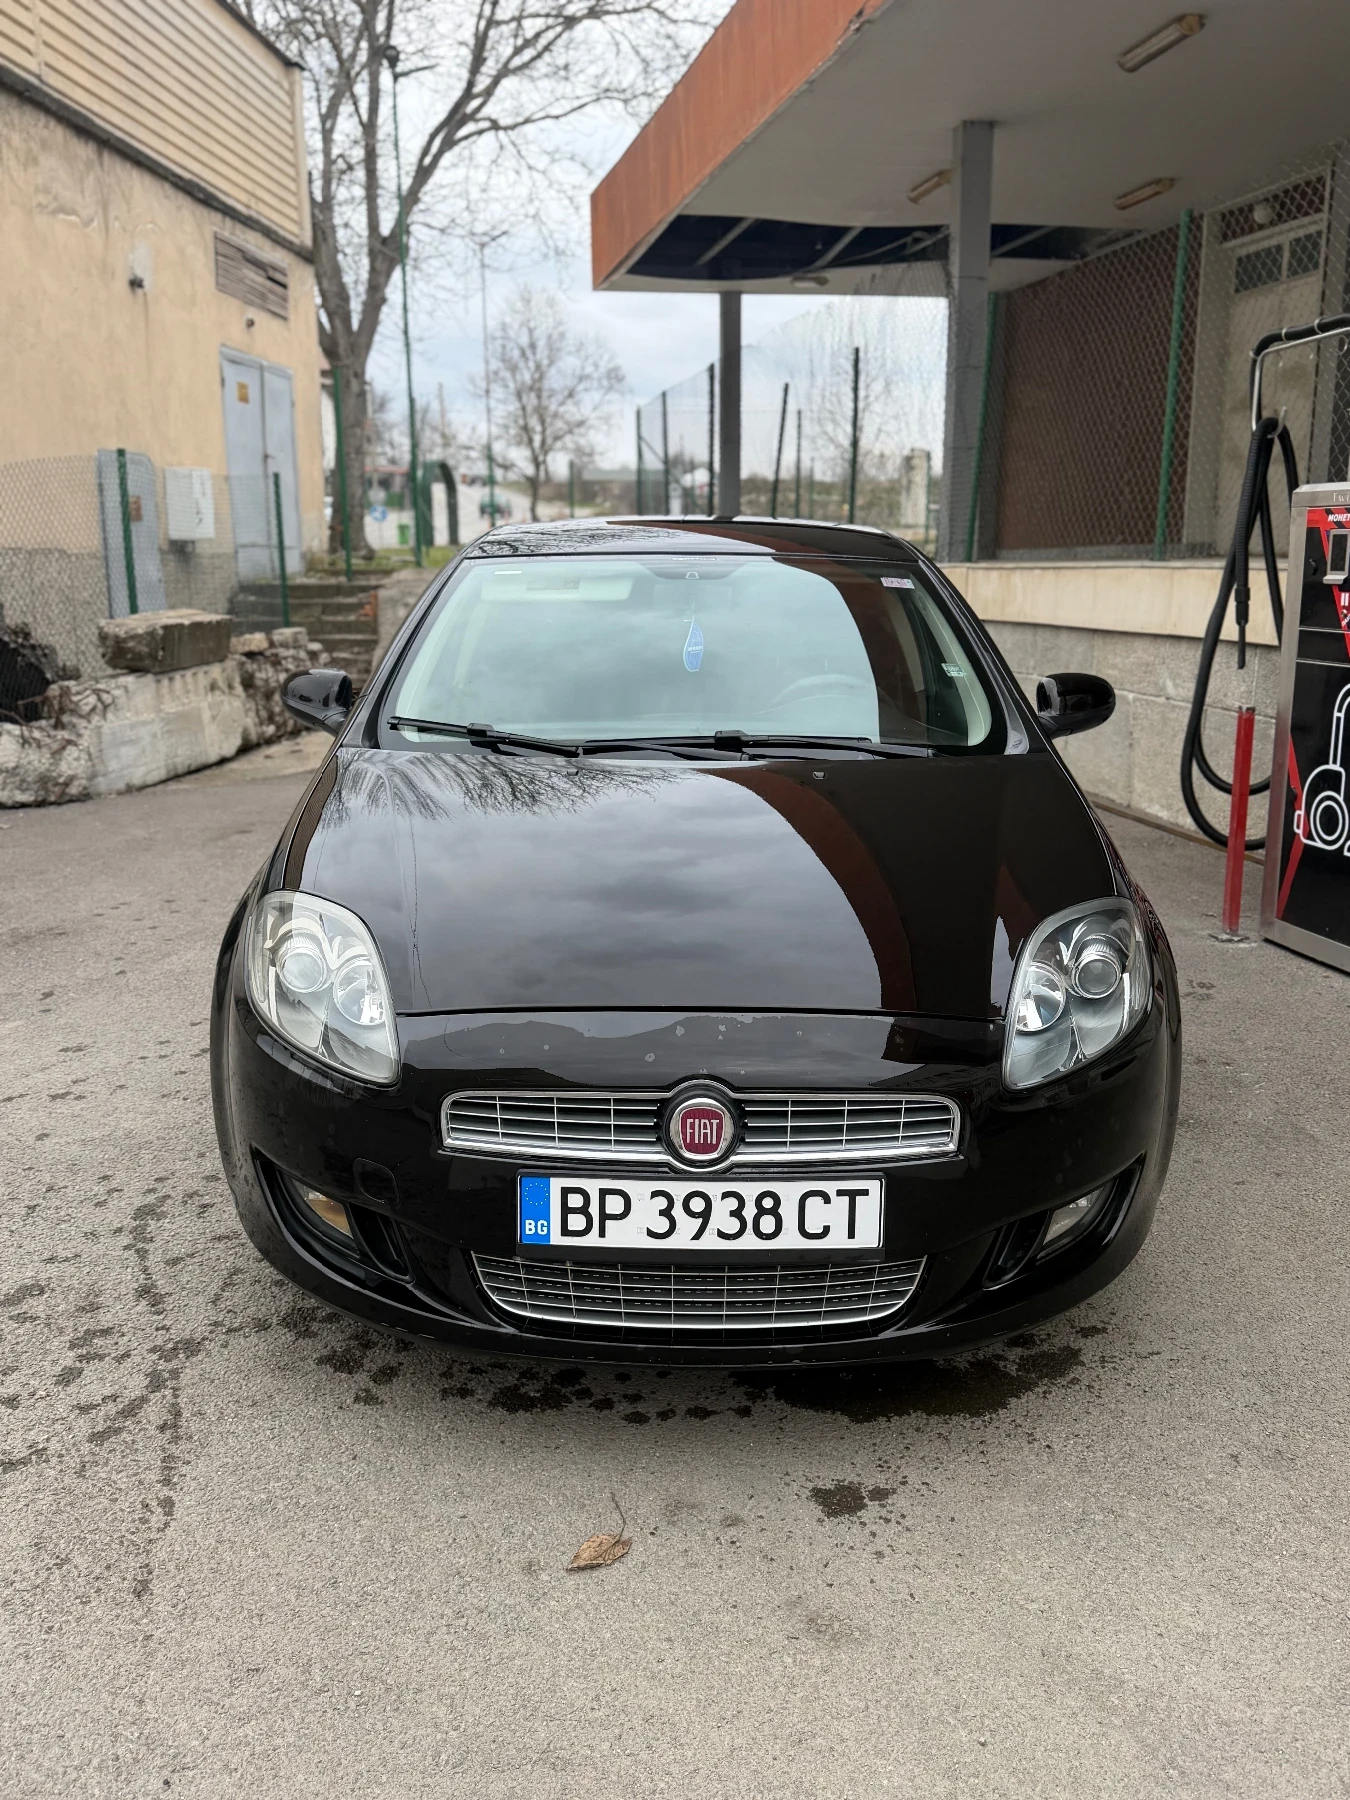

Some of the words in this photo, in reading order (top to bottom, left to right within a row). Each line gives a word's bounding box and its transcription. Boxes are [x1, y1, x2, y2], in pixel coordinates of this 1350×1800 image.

[686, 1118, 720, 1144] FIAT
[560, 1186, 632, 1239] BP
[646, 1189, 783, 1241] 3938
[798, 1188, 870, 1240] CT
[525, 1219, 548, 1235] BG
